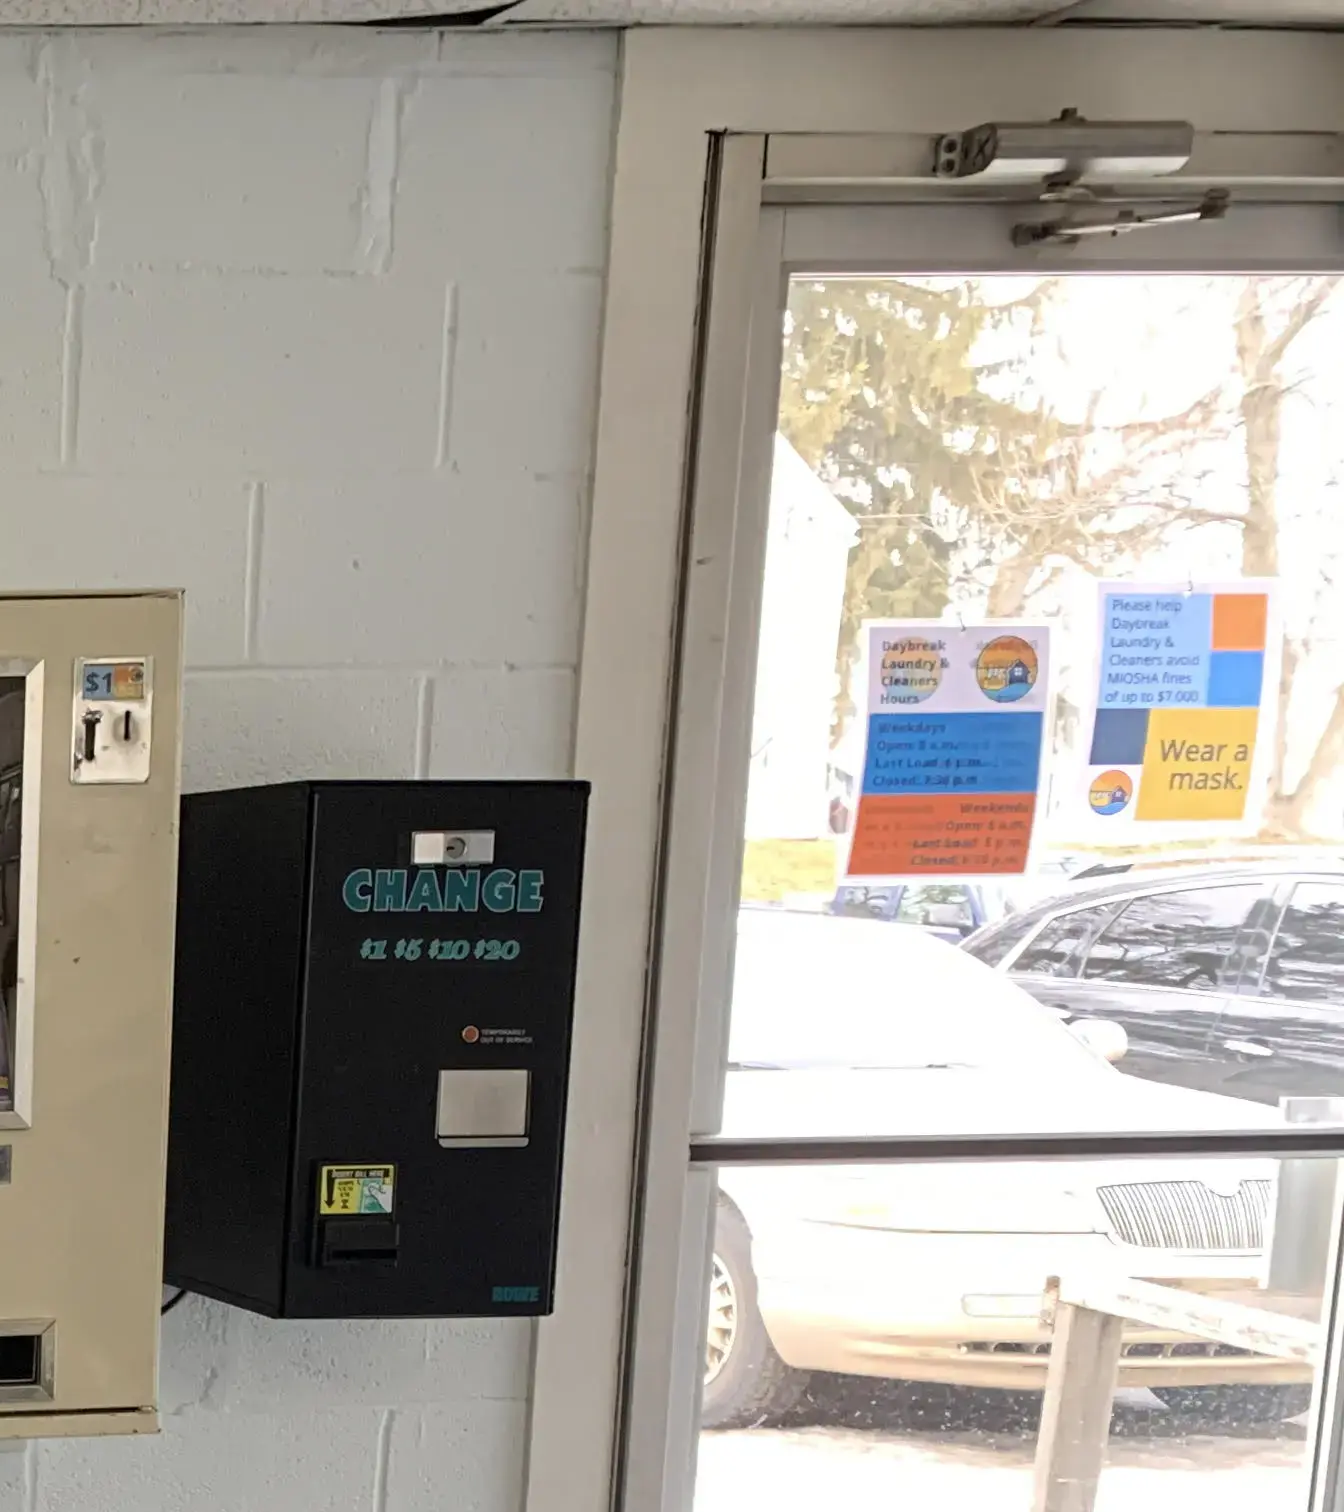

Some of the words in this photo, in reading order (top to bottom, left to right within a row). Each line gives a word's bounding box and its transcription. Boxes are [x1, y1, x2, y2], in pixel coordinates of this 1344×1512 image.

[1111, 598, 1152, 612] Please
[1155, 598, 1182, 615] help
[1111, 616, 1170, 632] Daybreak
[882, 640, 947, 654] Daybreak
[1110, 635, 1161, 651] Laundry
[1164, 636, 1175, 648] &
[881, 658, 937, 672] Laundry
[940, 658, 950, 669] &
[1109, 654, 1163, 666] Cleaners
[1166, 654, 1200, 666] avoid
[881, 676, 938, 687] Cleaners
[1107, 672, 1159, 684] MIOSHA
[1162, 671, 1192, 684] fines
[880, 693, 920, 705] Hours
[1104, 690, 1119, 703] of
[1121, 693, 1137, 705] up
[1140, 691, 1154, 703] to
[1159, 739, 1228, 763] Wear
[1233, 743, 1249, 763] a
[1168, 766, 1244, 791] mask.
[341, 867, 544, 913] CHANGE
[359, 938, 388, 961] $1
[428, 938, 471, 961] $10
[474, 938, 521, 961] $20
